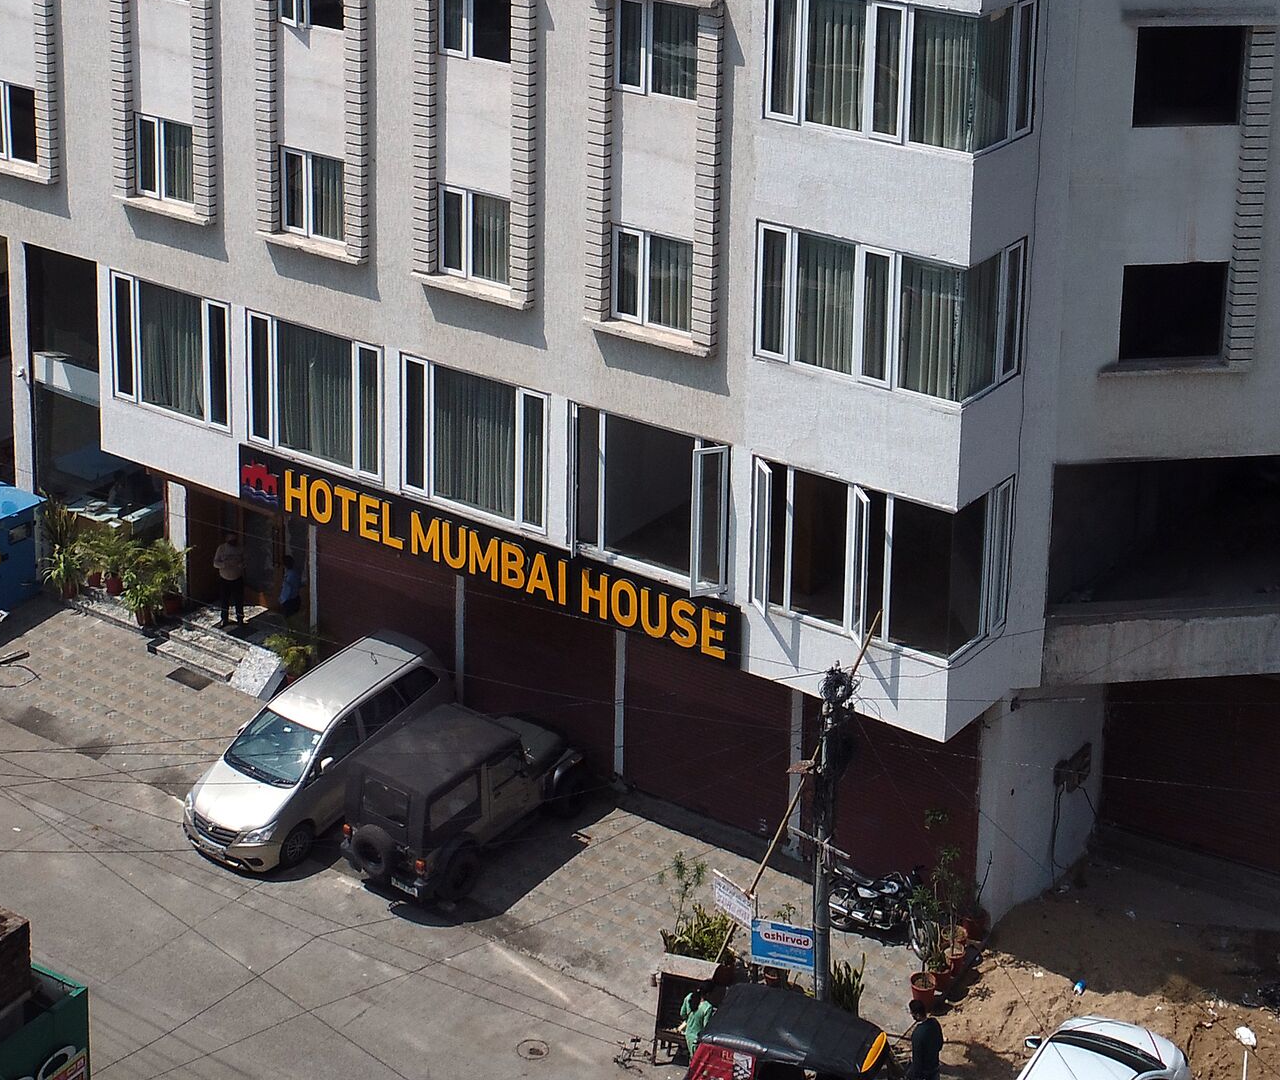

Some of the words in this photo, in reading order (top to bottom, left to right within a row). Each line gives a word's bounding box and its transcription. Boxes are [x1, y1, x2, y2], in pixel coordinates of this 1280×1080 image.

[285, 467, 405, 550] HOTEL
[410, 511, 567, 606] MUMBAI
[581, 568, 728, 660] HOUSE
[763, 929, 810, 947] ashirvad
